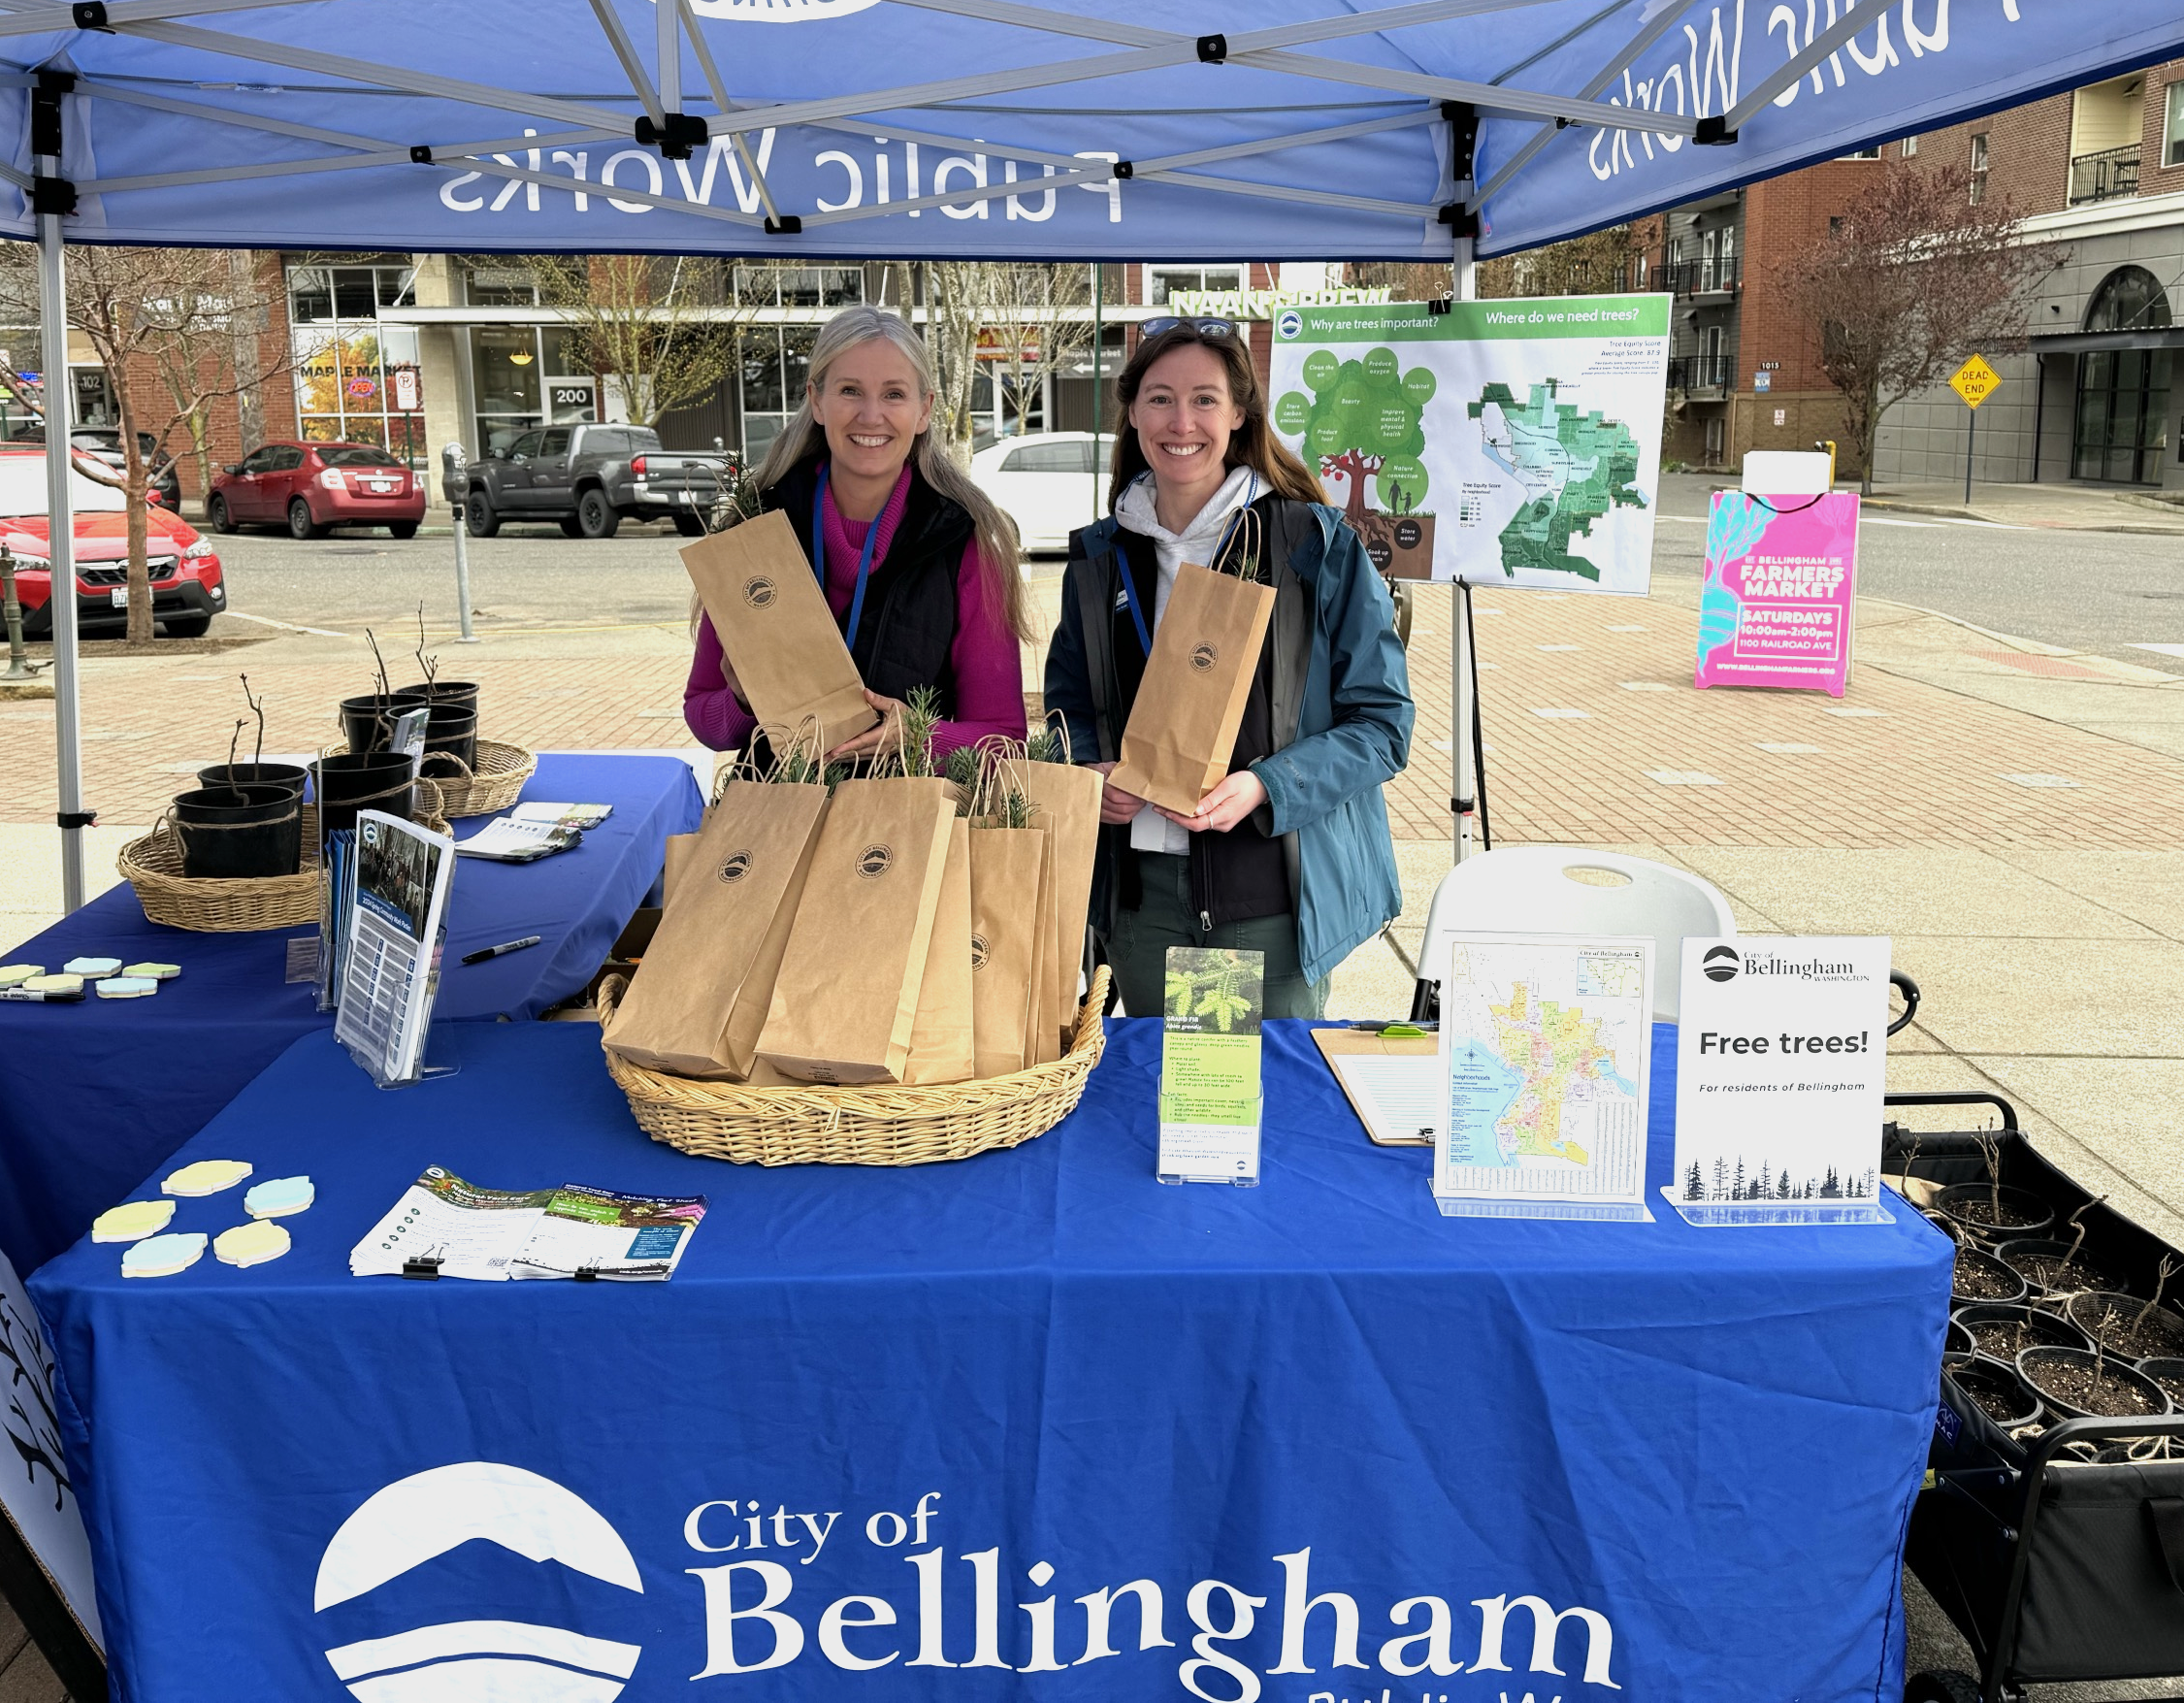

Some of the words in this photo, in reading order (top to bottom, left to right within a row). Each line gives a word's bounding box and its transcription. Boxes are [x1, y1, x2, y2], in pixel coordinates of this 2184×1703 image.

[1172, 290, 1264, 318] NAAN
[1485, 311, 1525, 324] Where
[1528, 311, 1544, 323] do
[1548, 312, 1564, 322] we
[1567, 309, 1598, 322] need
[1602, 308, 1640, 321] trees?
[1311, 319, 1334, 334] Why
[1353, 320, 1379, 329] trees
[1381, 316, 1439, 331] important?
[301, 366, 353, 377] MAPLE
[1962, 371, 1988, 380] DEAD
[81, 375, 101, 388] 102
[1965, 383, 1984, 394] END
[556, 390, 586, 403] 200
[1758, 556, 1826, 565] BELLINGHAM
[1741, 565, 1844, 582] FARMERS
[1744, 580, 1839, 598] MARKET
[1742, 610, 1832, 625] SATURDAYS
[1741, 625, 1833, 640] 10:00am-2:00pm
[1761, 639, 1811, 650] RAILROAD
[1812, 641, 1832, 650] AVE
[1744, 951, 1763, 961] City
[1744, 958, 1854, 981] Bellingham
[1700, 1032, 1770, 1055] Free
[1779, 1031, 1869, 1054] trees!
[1699, 1084, 1718, 1093] For
[1722, 1083, 1778, 1092] residents
[1781, 1083, 1794, 1092] of
[1797, 1082, 1865, 1093] Bellingham
[682, 1498, 843, 1565] City
[864, 1491, 941, 1548] of
[683, 1545, 1622, 1703] Bellingham
